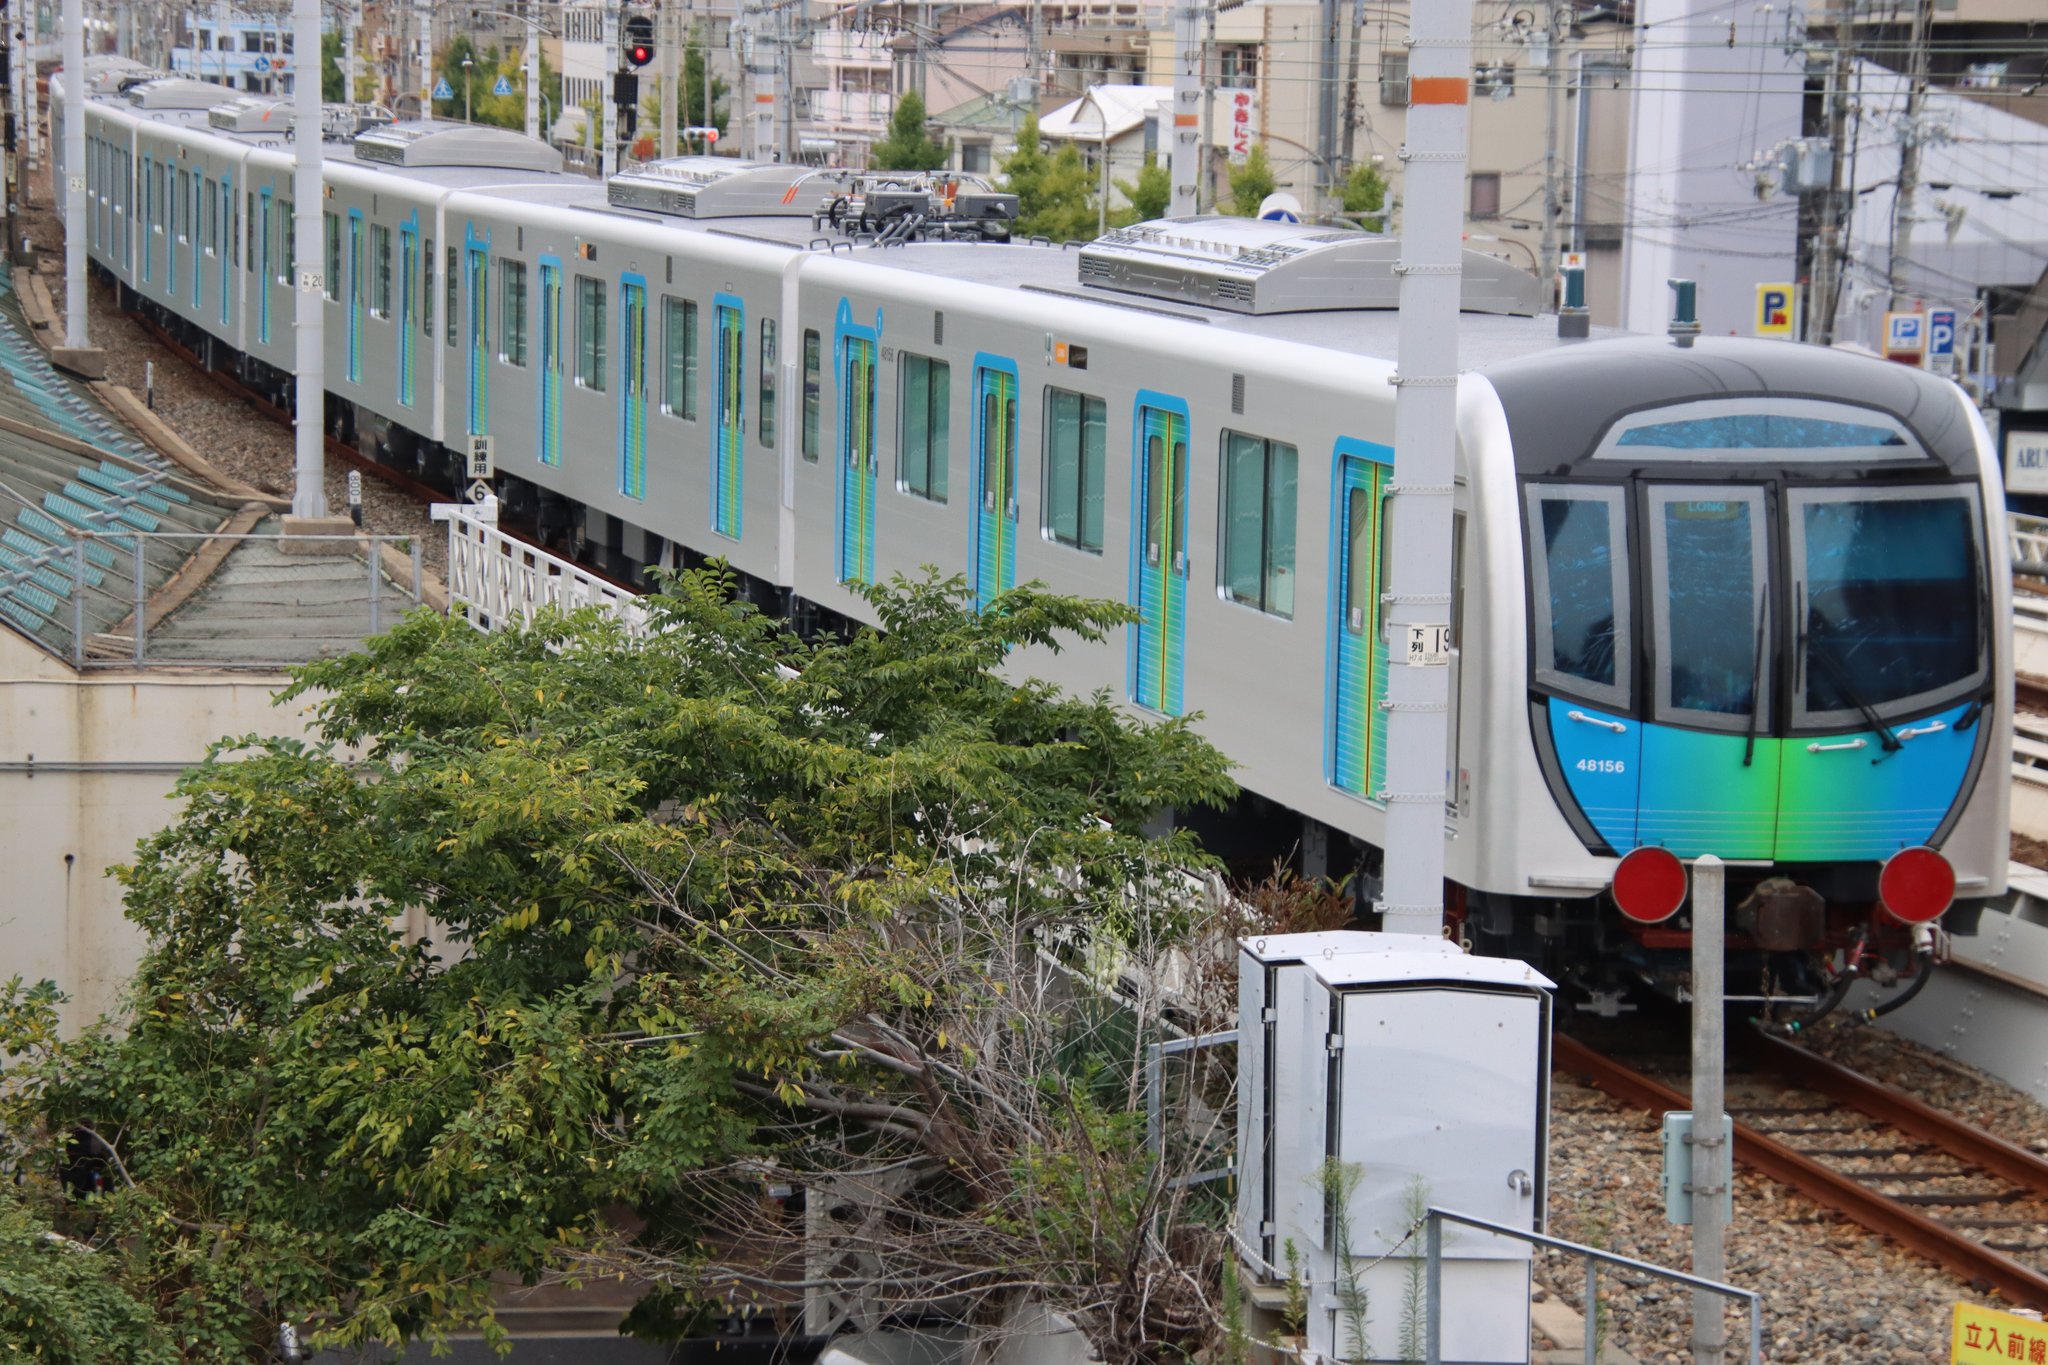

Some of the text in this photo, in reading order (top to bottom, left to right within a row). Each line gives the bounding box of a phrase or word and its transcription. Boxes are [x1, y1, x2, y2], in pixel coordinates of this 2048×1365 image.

[1763, 291, 1785, 325] P
[1896, 320, 1916, 337] P
[1933, 325, 1952, 352] P
[473, 439, 488, 474] 訓練用
[351, 475, 360, 496] 800
[474, 484, 485, 501] 6
[1688, 500, 1727, 513] LONG
[1411, 628, 1424, 653] 下列
[1435, 628, 1449, 653] 19
[1576, 758, 1625, 773] 48156
[1964, 1321, 2047, 1365] 立入前線
